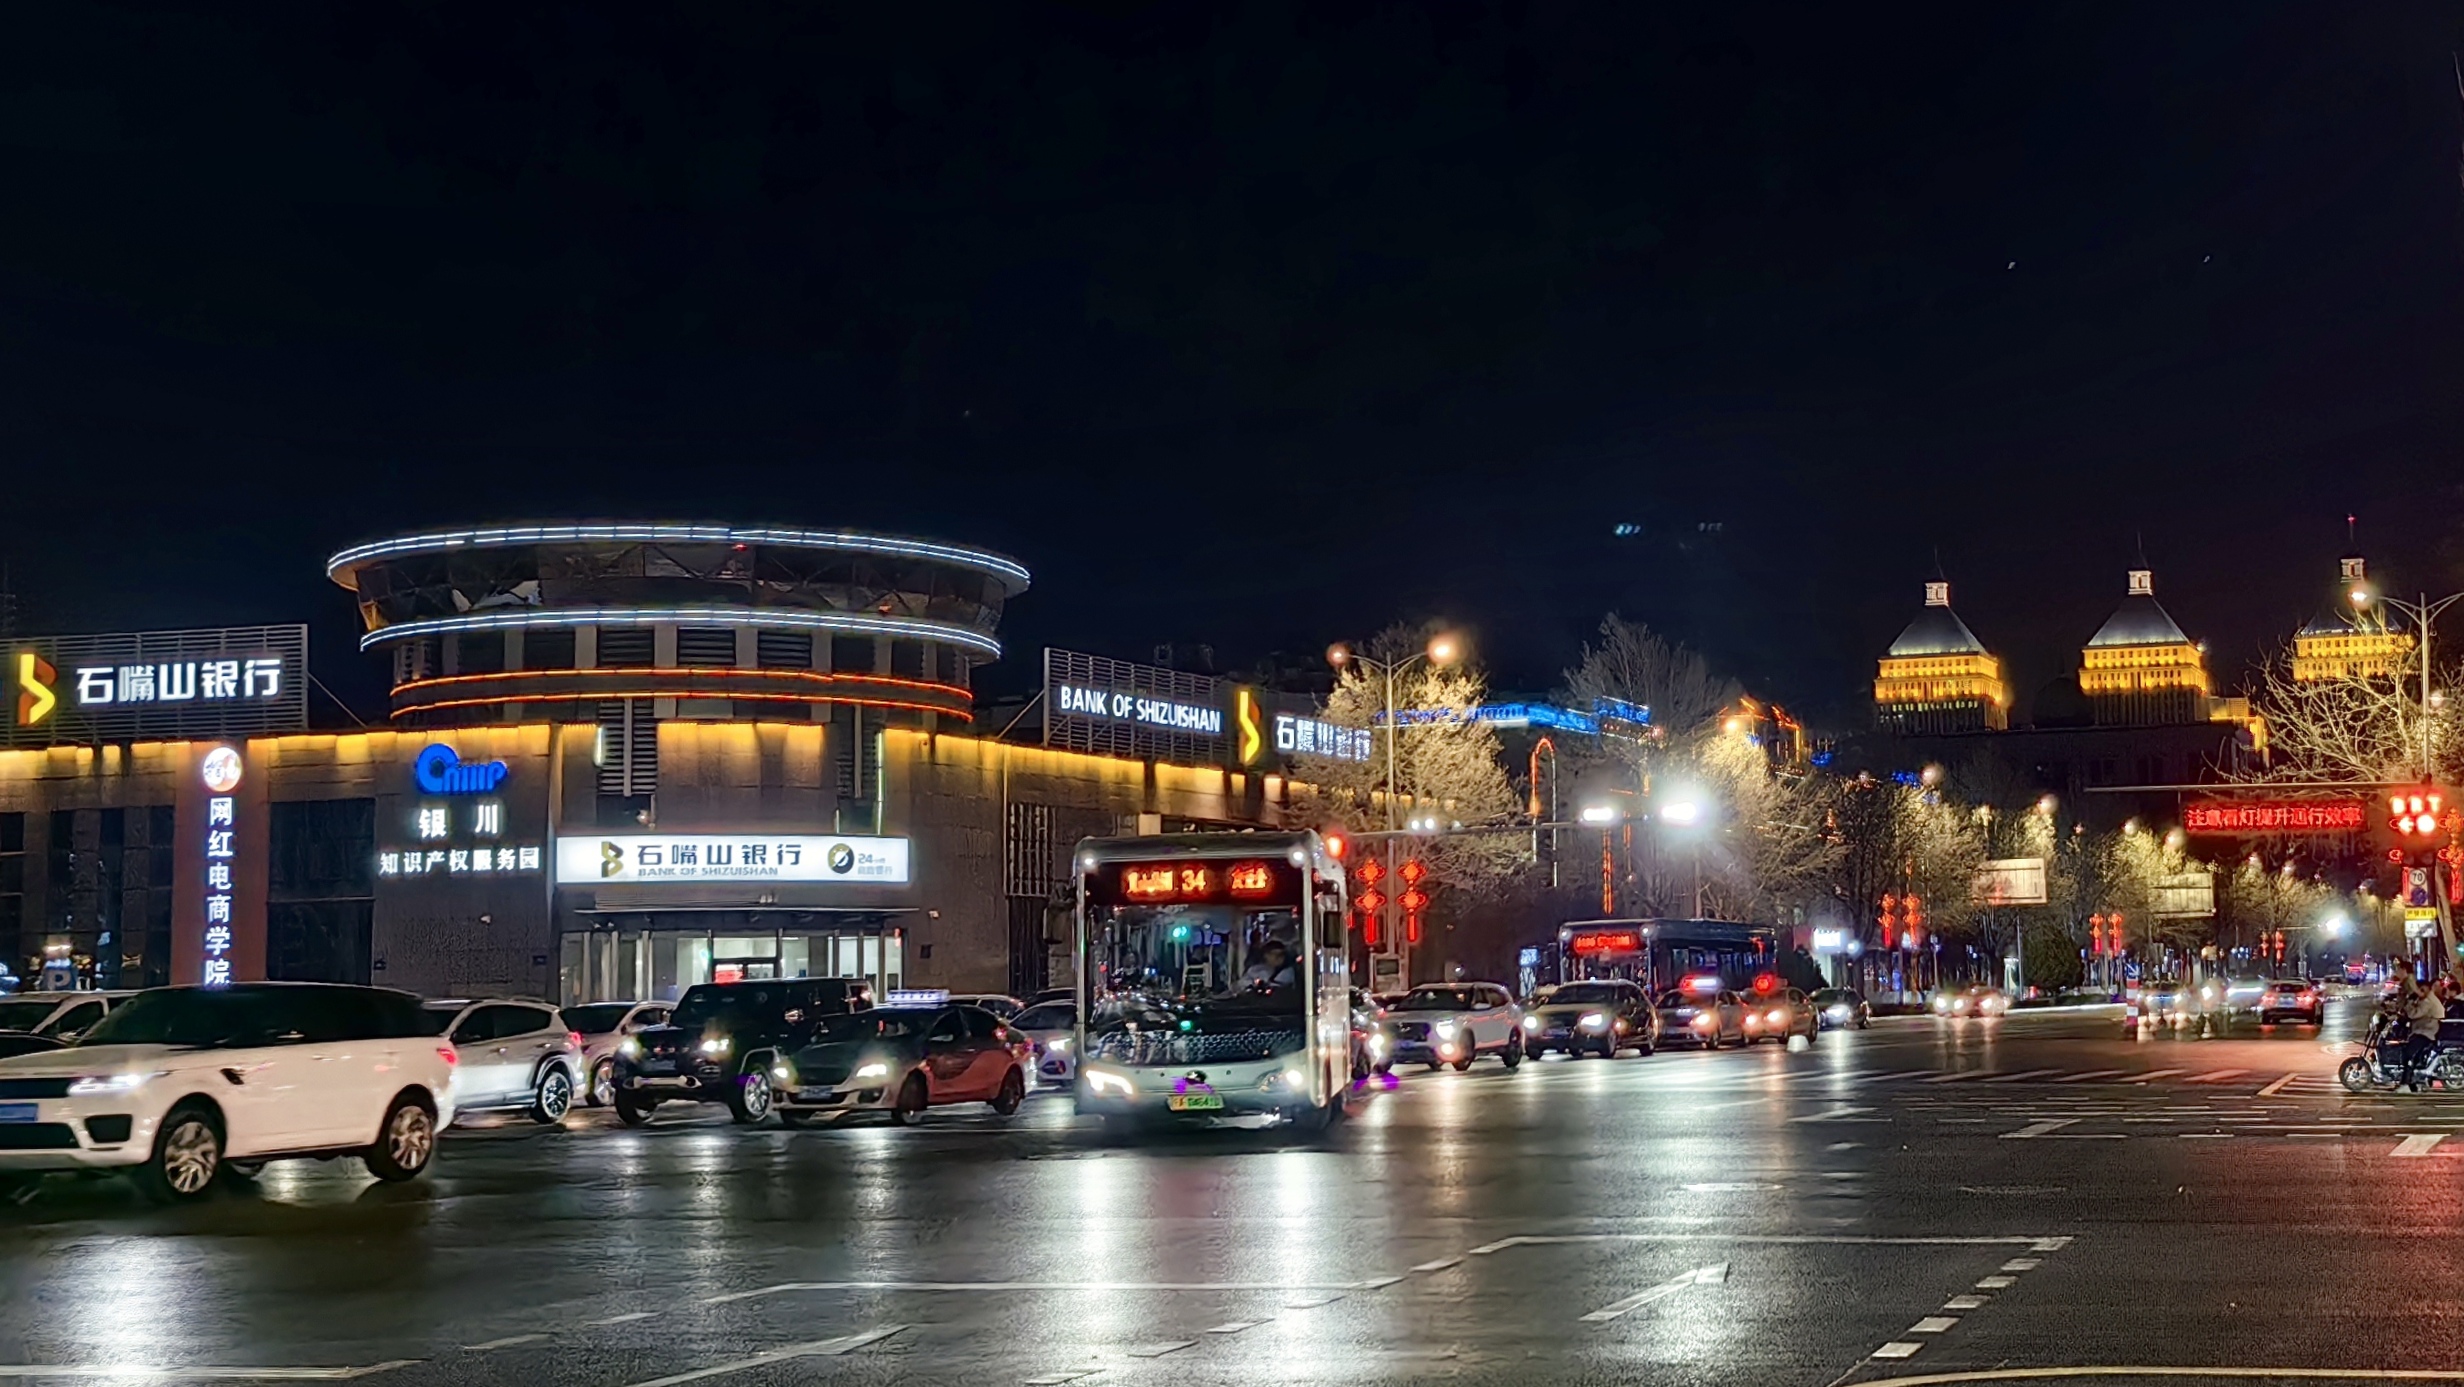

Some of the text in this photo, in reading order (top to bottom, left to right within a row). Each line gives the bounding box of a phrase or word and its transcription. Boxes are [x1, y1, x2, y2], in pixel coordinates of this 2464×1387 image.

[76, 659, 281, 705] 石嘴山银行
[1060, 684, 1221, 733] BANK OF SHIZUISHAN
[378, 846, 540, 876] 知识产权服务园
[637, 844, 802, 866] 石嘴山银行
[637, 867, 779, 877] BANK OF SHIZUISHAN
[1181, 869, 1206, 892] 34
[2412, 873, 2423, 882] 70
[203, 796, 234, 986] 网红电商学院
